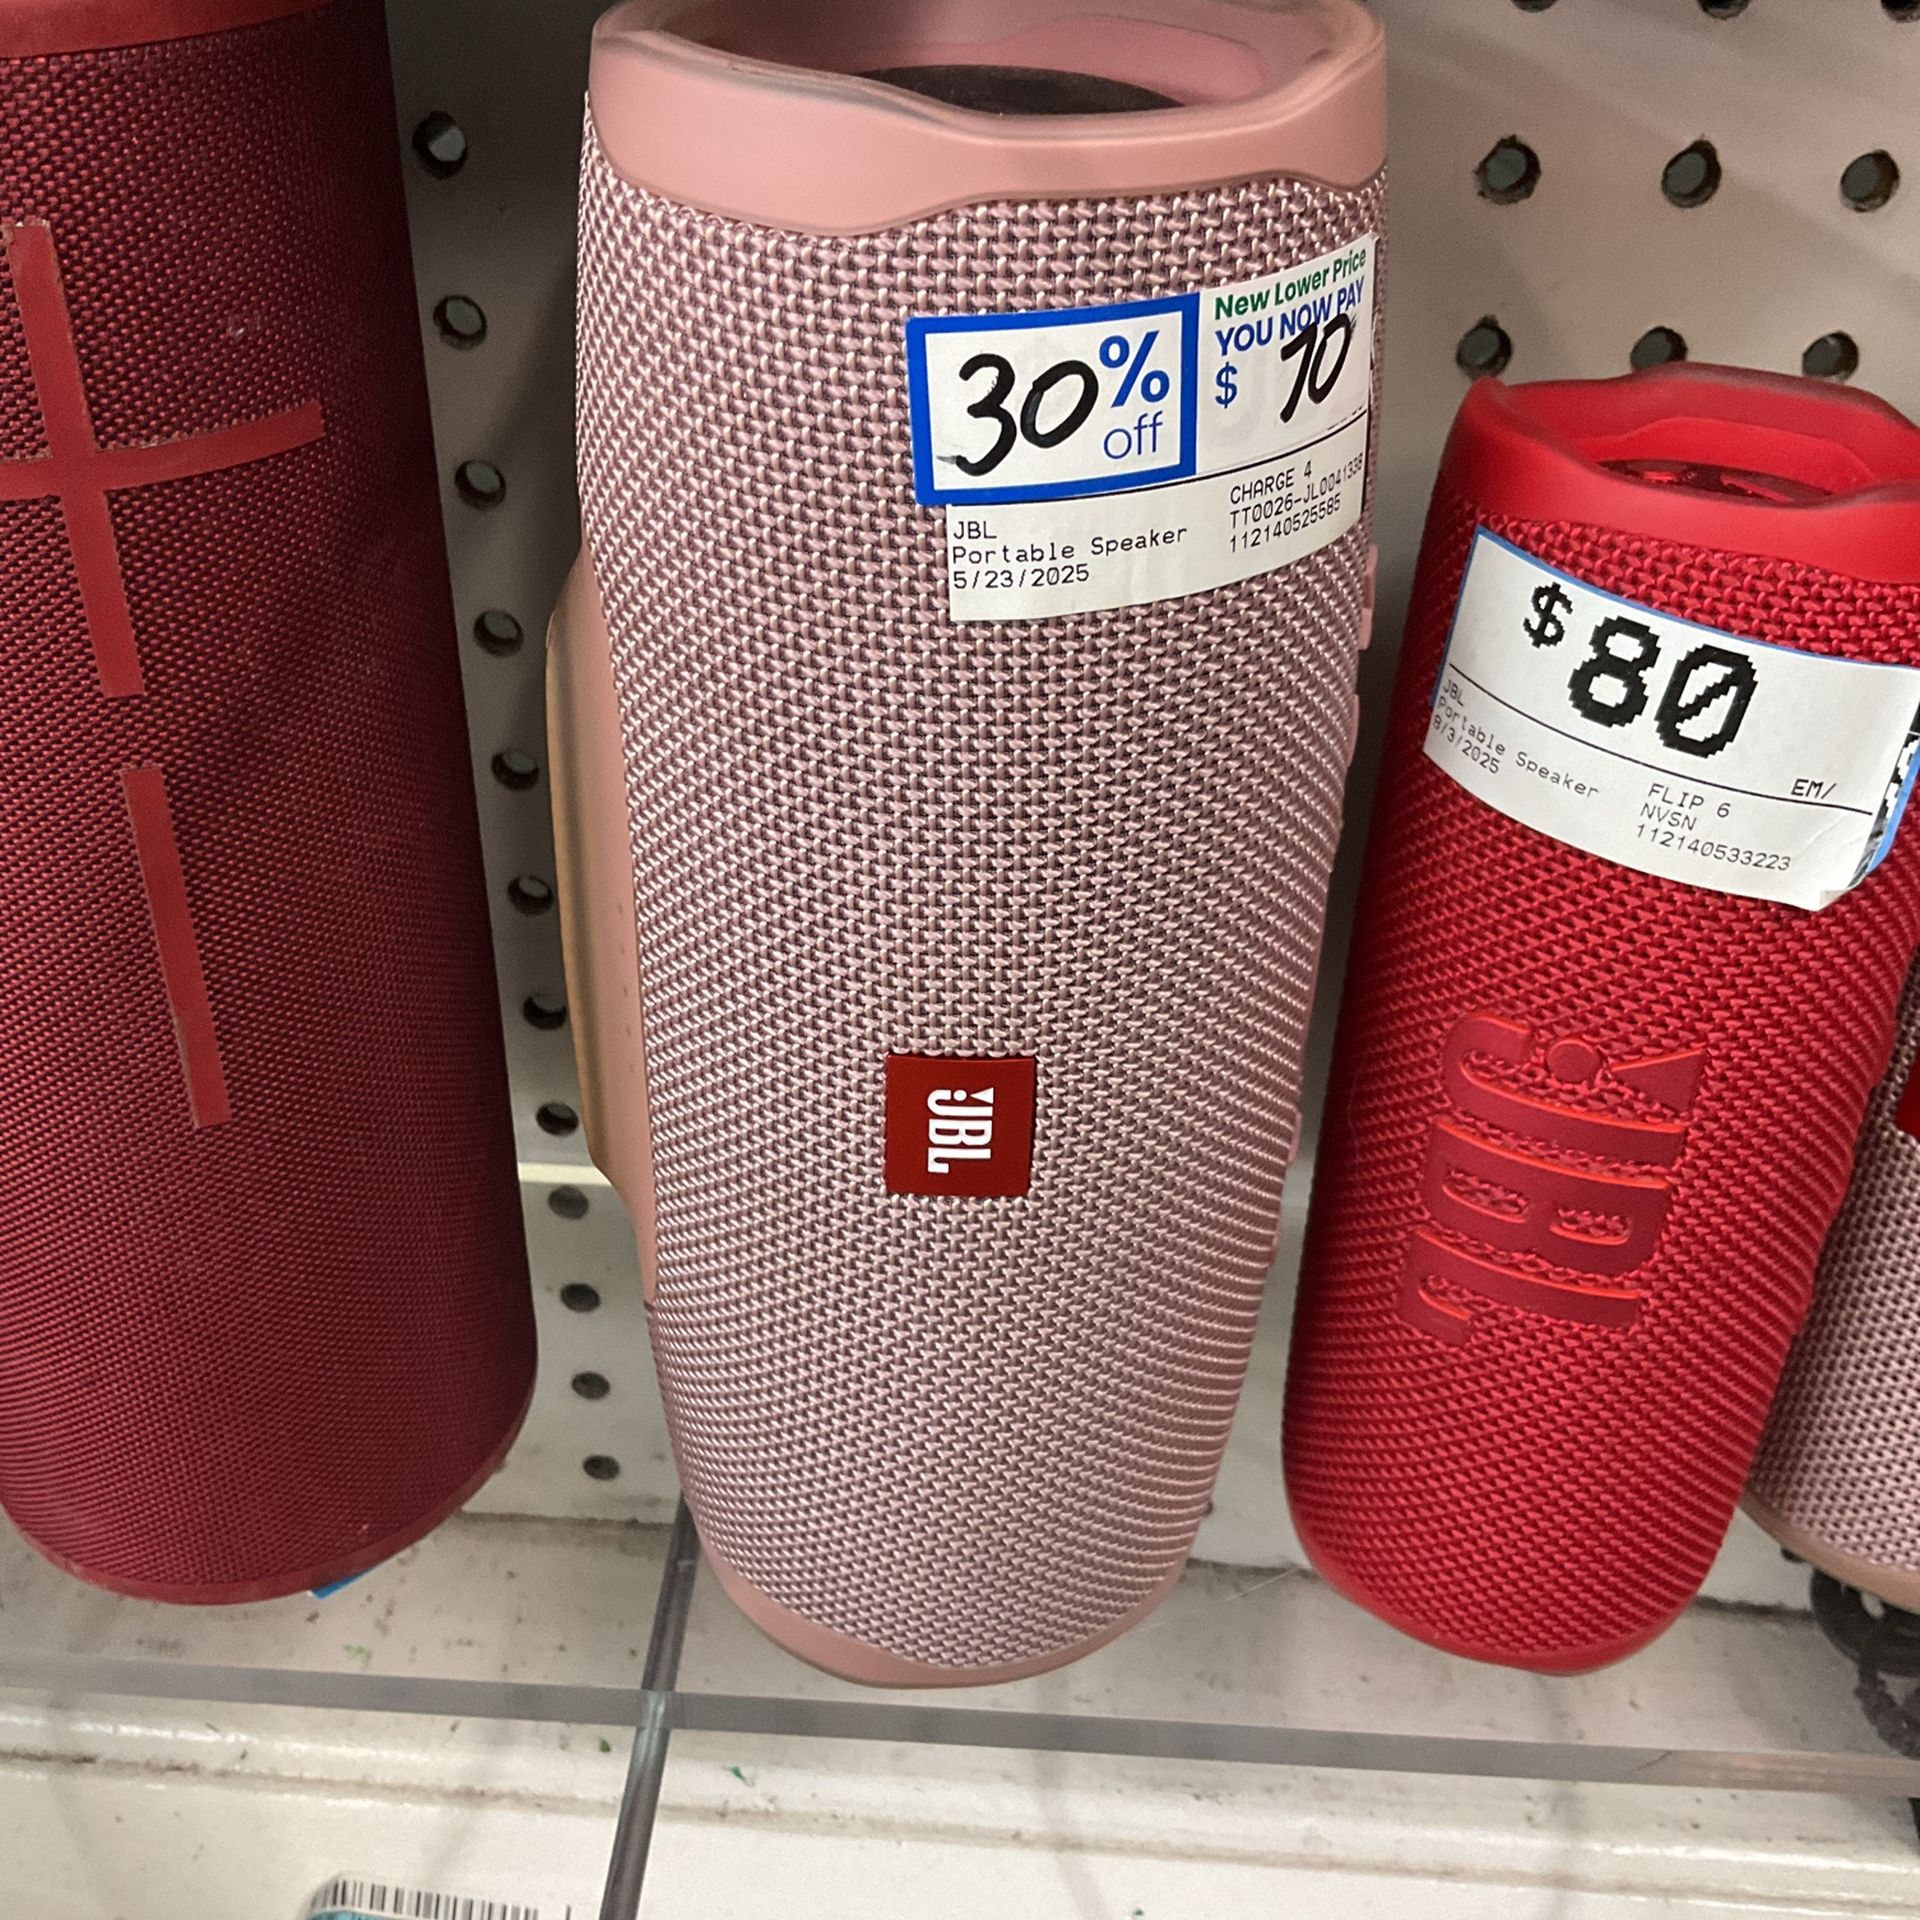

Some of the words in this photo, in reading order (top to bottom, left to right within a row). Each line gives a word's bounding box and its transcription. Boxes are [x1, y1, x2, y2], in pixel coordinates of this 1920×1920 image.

[1215, 288, 1270, 320] New
[1274, 266, 1329, 306] Lower
[1332, 249, 1366, 283] Price
[1215, 317, 1273, 356] YOU
[1280, 293, 1333, 340] NOW
[1336, 275, 1365, 318] PAY
[1103, 410, 1163, 459] off
[1230, 468, 1295, 504] CHARGE
[1303, 460, 1312, 478] 4
[953, 521, 997, 539] JBL
[1230, 492, 1341, 553] 112140525585
[952, 542, 1075, 564] Portable
[1091, 528, 1187, 556] Speaker
[953, 563, 1090, 589] 5/23/2025
[1443, 679, 1464, 707] JBL
[1432, 714, 1501, 774] 8/3/2025
[1437, 695, 1506, 756] Portable
[1515, 751, 1599, 798] Speaker
[1640, 802, 1697, 831] NVSN
[1648, 783, 1704, 810] FLIP
[1716, 803, 1731, 818] 6
[1637, 824, 1791, 870] 112140533223
[927, 1087, 994, 1174] JBL
